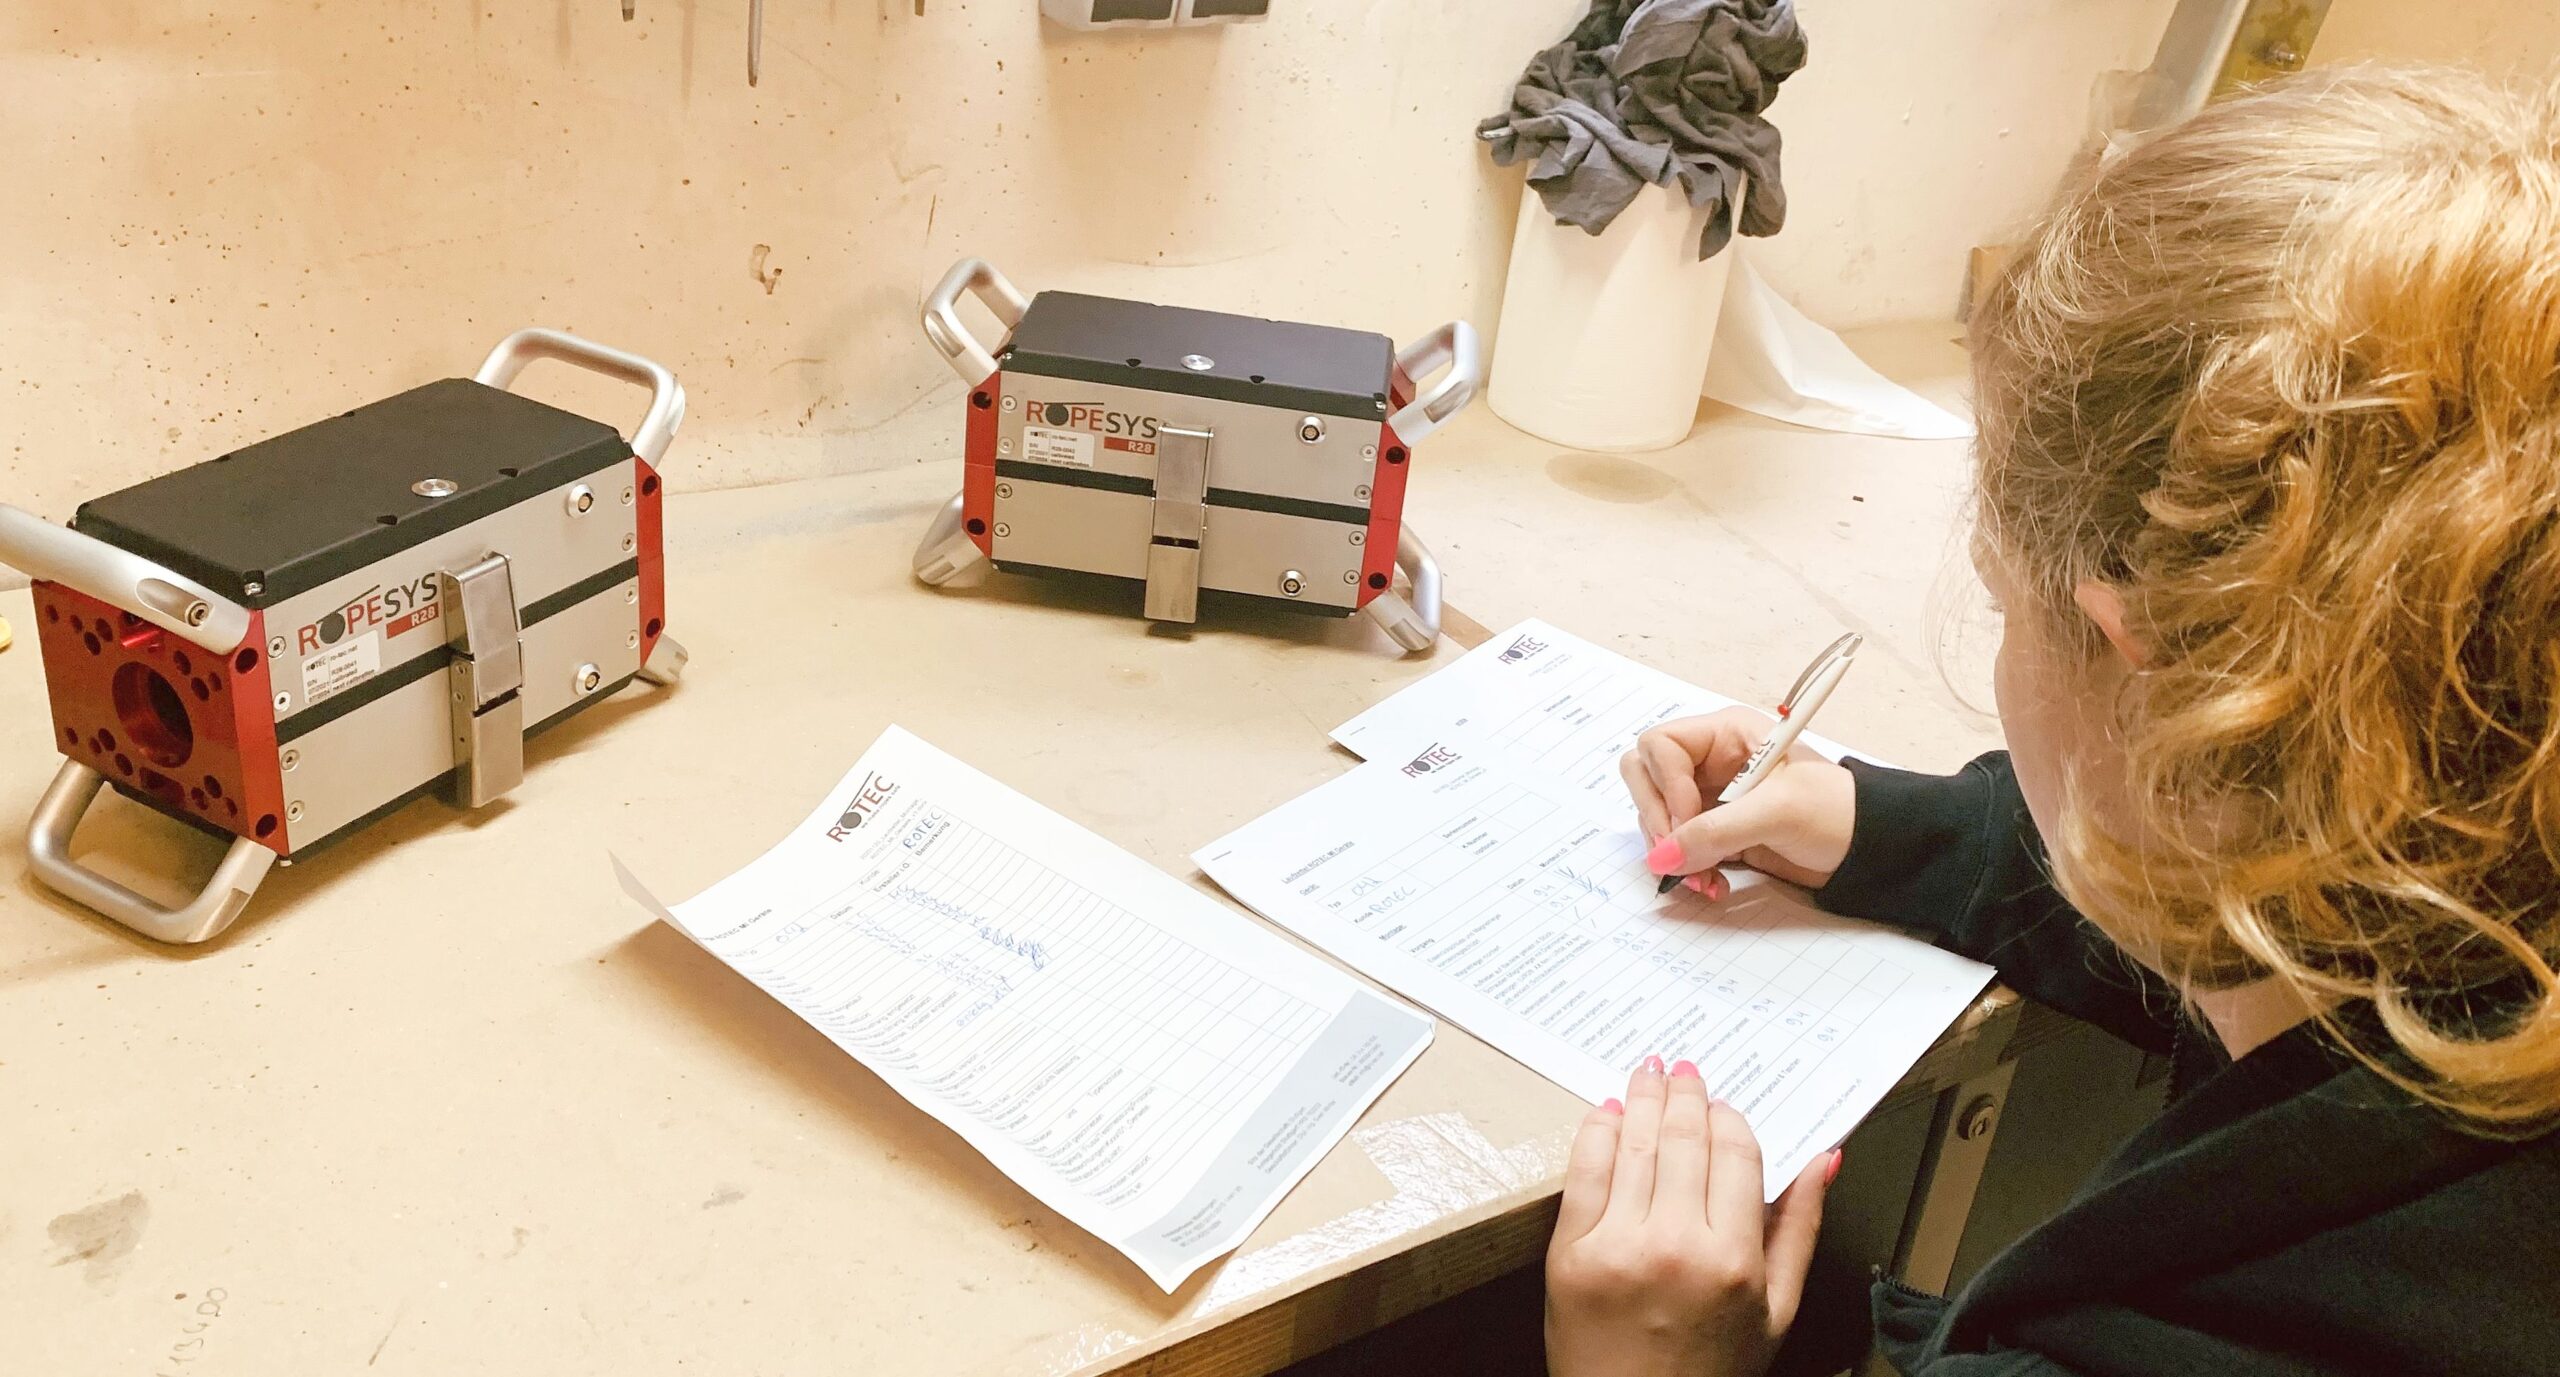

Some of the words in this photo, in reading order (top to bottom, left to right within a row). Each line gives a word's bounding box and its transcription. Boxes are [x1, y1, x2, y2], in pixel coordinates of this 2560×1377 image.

[1026, 401, 1158, 438] ROPESYS
[1128, 441, 1152, 454] R28
[298, 572, 438, 656] ROPESYS
[411, 607, 436, 627] R28
[1498, 637, 1544, 664] ROTEC
[1401, 746, 1457, 778] ROTEC
[826, 774, 895, 843] ROTEC
[903, 812, 943, 850] ROTEC
[830, 905, 853, 920] Datum
[915, 821, 950, 856] Bemerkung
